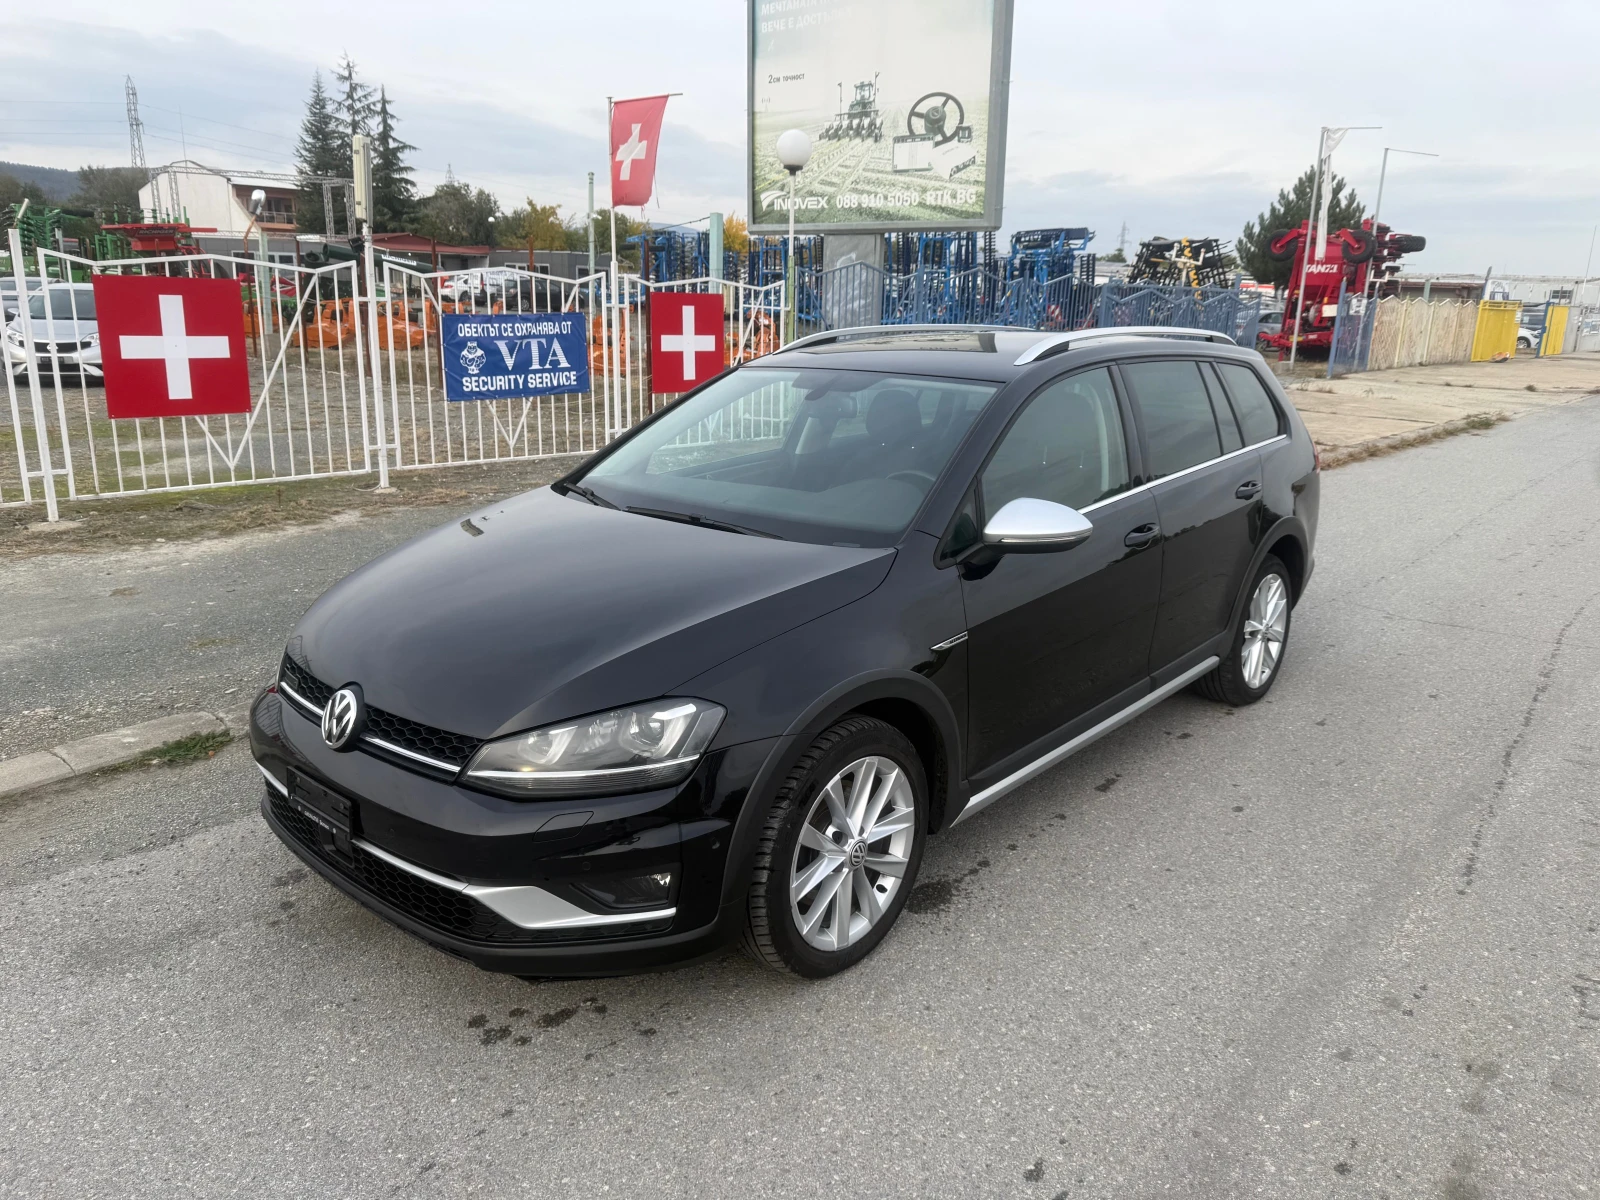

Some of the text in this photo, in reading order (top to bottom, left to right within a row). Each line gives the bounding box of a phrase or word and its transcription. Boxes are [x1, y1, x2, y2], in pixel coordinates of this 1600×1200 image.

[761, 18, 786, 33] ВЕЧЕ
[788, 17, 795, 29] Е
[774, 196, 829, 211] INOVEX
[836, 187, 976, 209] 088 910 5050 RTK.BG
[457, 321, 572, 337] ОБЕКТЪТ СЕ ОХРАНЯВА ОТ
[493, 336, 571, 371] VTA
[462, 371, 577, 392] SECURITY SERVICE
